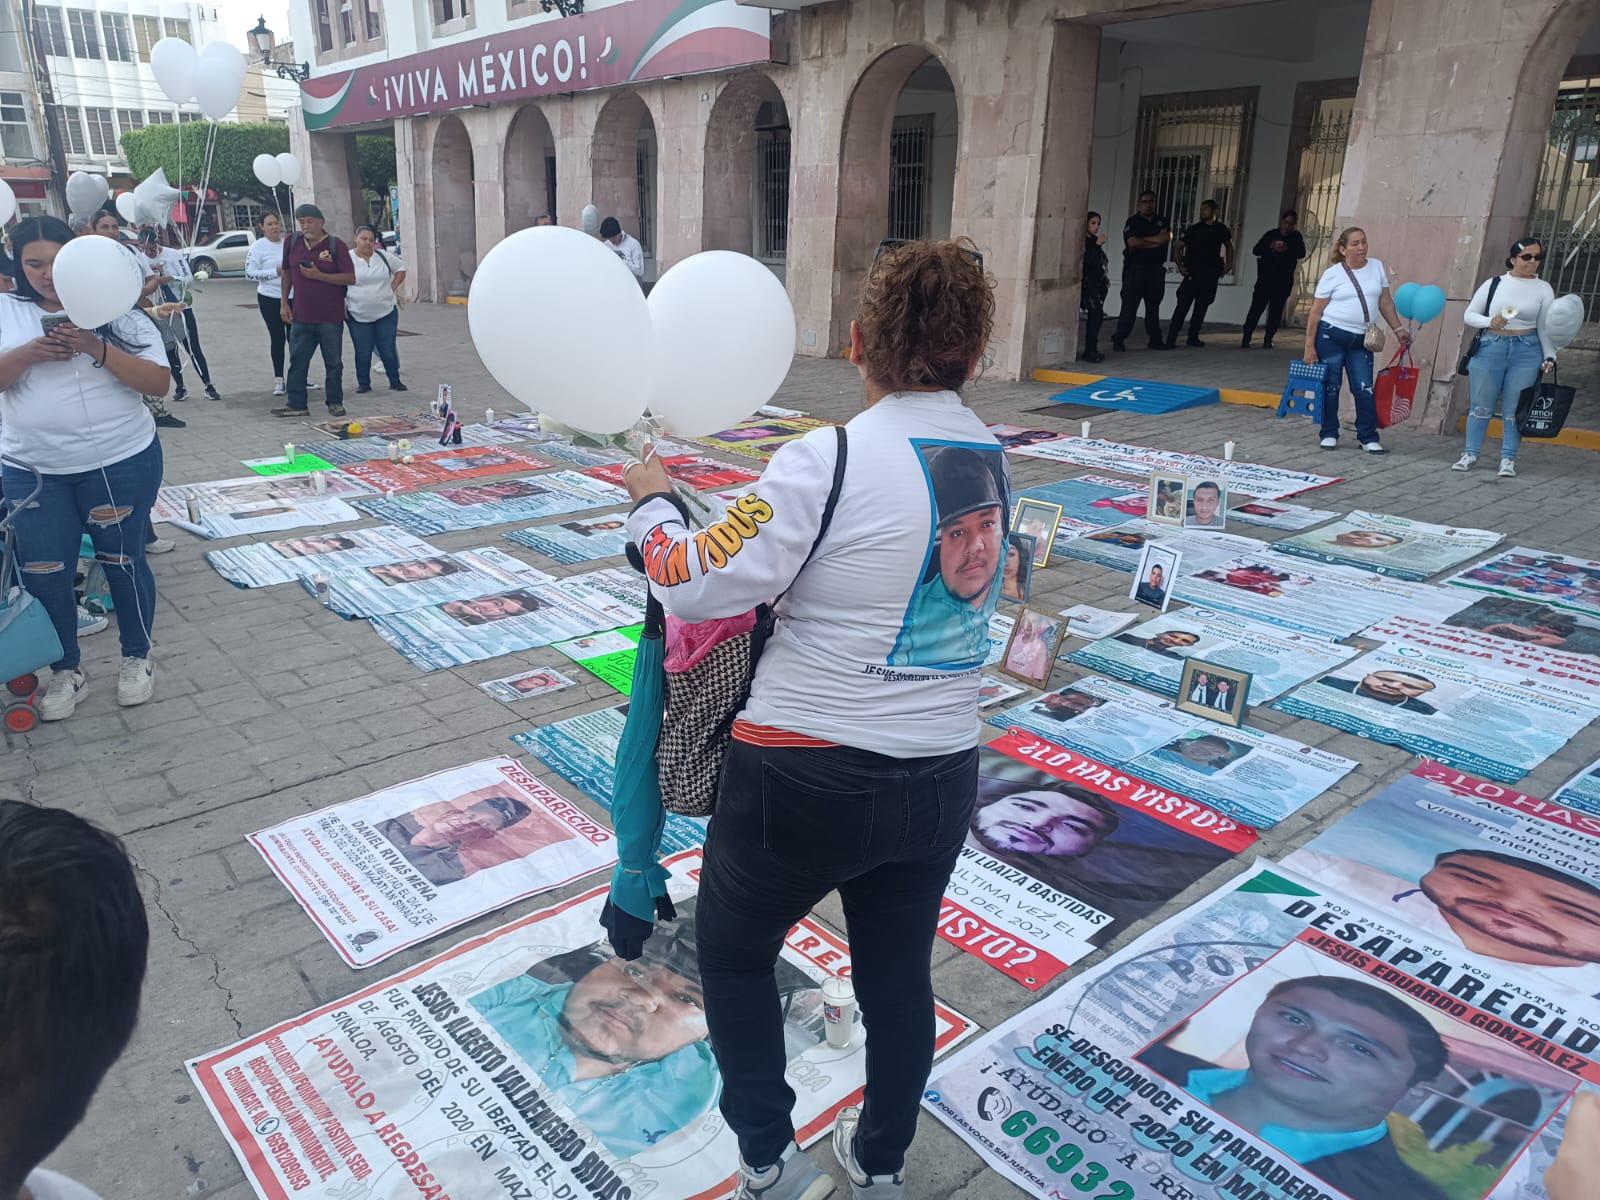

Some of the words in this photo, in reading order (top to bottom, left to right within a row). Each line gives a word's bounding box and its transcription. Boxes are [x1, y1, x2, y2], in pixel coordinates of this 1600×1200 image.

[383, 68, 448, 113] ¡VIVA
[458, 35, 589, 98] MÉXICO!
[500, 765, 610, 843] DESAPARECIDO
[1017, 741, 1073, 768] ¿LO
[1066, 761, 1131, 793] HAS
[1129, 784, 1238, 835] VISTO?
[1424, 772, 1504, 797] ¿LO
[351, 820, 385, 851] DANIEL
[380, 848, 412, 876] RIVAS
[406, 874, 438, 902] MENA
[1427, 802, 1473, 824] Visto
[1474, 821, 1512, 836] por
[1515, 835, 1578, 862] última
[1489, 835, 1550, 860] enero
[1554, 859, 1588, 875] del
[317, 817, 339, 840] ENERO
[333, 835, 350, 853] DEL
[355, 860, 369, 876] EN
[392, 898, 424, 928] SINALOA
[329, 861, 365, 897] REGRESAR
[364, 900, 379, 912] SU
[374, 908, 399, 934] CASA!
[365, 852, 377, 867] SU
[399, 886, 410, 899] EL
[425, 912, 438, 926] DE
[975, 856, 1029, 887] LOAIZA
[1026, 883, 1110, 926] BASTIDAS
[970, 896, 1005, 919] DEL
[1007, 917, 1052, 942] 2021
[1015, 899, 1055, 922] VEZ
[1051, 919, 1075, 938] EL
[1322, 901, 1351, 917] NOS
[1358, 916, 1414, 945] FALTAS
[1460, 962, 1492, 980] NOS
[1500, 981, 1567, 1016] FALTAN
[331, 1011, 378, 1062] SINALOA.
[1375, 962, 1470, 1019] EDUARDO
[1469, 1010, 1591, 1076] GONZÁLEZ
[224, 1066, 264, 1115] COMUNICATE
[251, 1110, 270, 1126] AL
[248, 1056, 296, 1117] RECOMPENSADA
[306, 1034, 376, 1110] ¡AYUDALO
[364, 1111, 386, 1126] A
[358, 1000, 379, 1017] DE
[373, 1020, 419, 1067] AGOSTO
[416, 1068, 444, 1100] DEL
[440, 1101, 475, 1133] 2020
[470, 1133, 499, 1162] EN
[384, 987, 410, 1011] FUE
[402, 1008, 451, 1060] PRIVADO
[444, 1057, 469, 1078] DE
[460, 1076, 486, 1098] SU
[477, 1096, 540, 1162] LIBERTAD
[534, 1161, 557, 1187] EL
[411, 982, 460, 1022] JESUS
[442, 1015, 508, 1073] ALBERTO
[491, 1064, 586, 1163] VALDENEGRO
[1045, 1023, 1073, 1044] SE
[1070, 1037, 1184, 1117] DESCONOCE
[1180, 1109, 1215, 1136] SU
[321, 1117, 359, 1159] POSITIVA
[936, 1101, 954, 1116] POR
[952, 1112, 970, 1131] LAS
[967, 1125, 996, 1151] VOCES
[994, 1146, 1009, 1162] SIN
[1005, 1156, 1045, 1188] JUSTICIA
[1033, 1046, 1097, 1092] ENERO
[1091, 1088, 1132, 1120] DEL
[1129, 1112, 1194, 1158] 2020
[1189, 1151, 1229, 1181] EN
[1116, 1153, 1143, 1170] A
